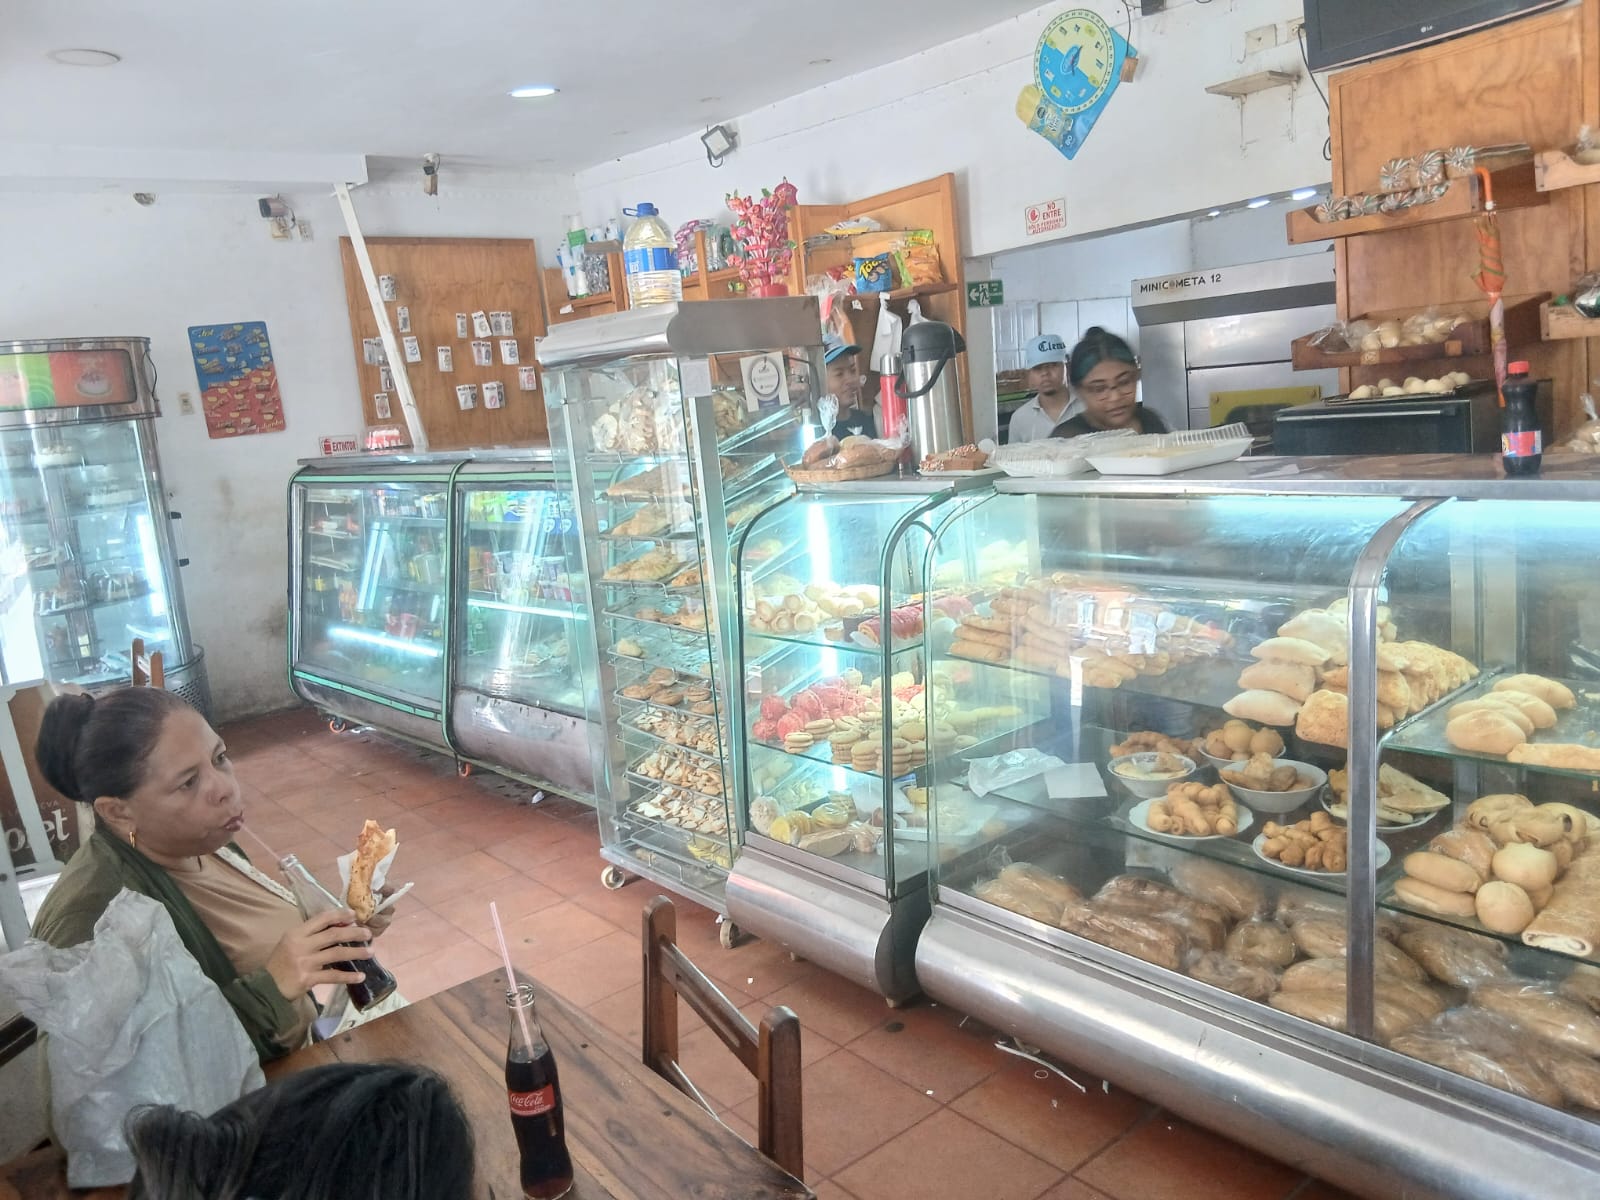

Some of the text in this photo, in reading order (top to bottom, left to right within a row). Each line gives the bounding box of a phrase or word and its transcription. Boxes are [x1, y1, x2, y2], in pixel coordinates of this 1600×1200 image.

[1047, 201, 1056, 211] NO
[1042, 209, 1062, 220] ENTRE
[1211, 273, 1221, 284] 12
